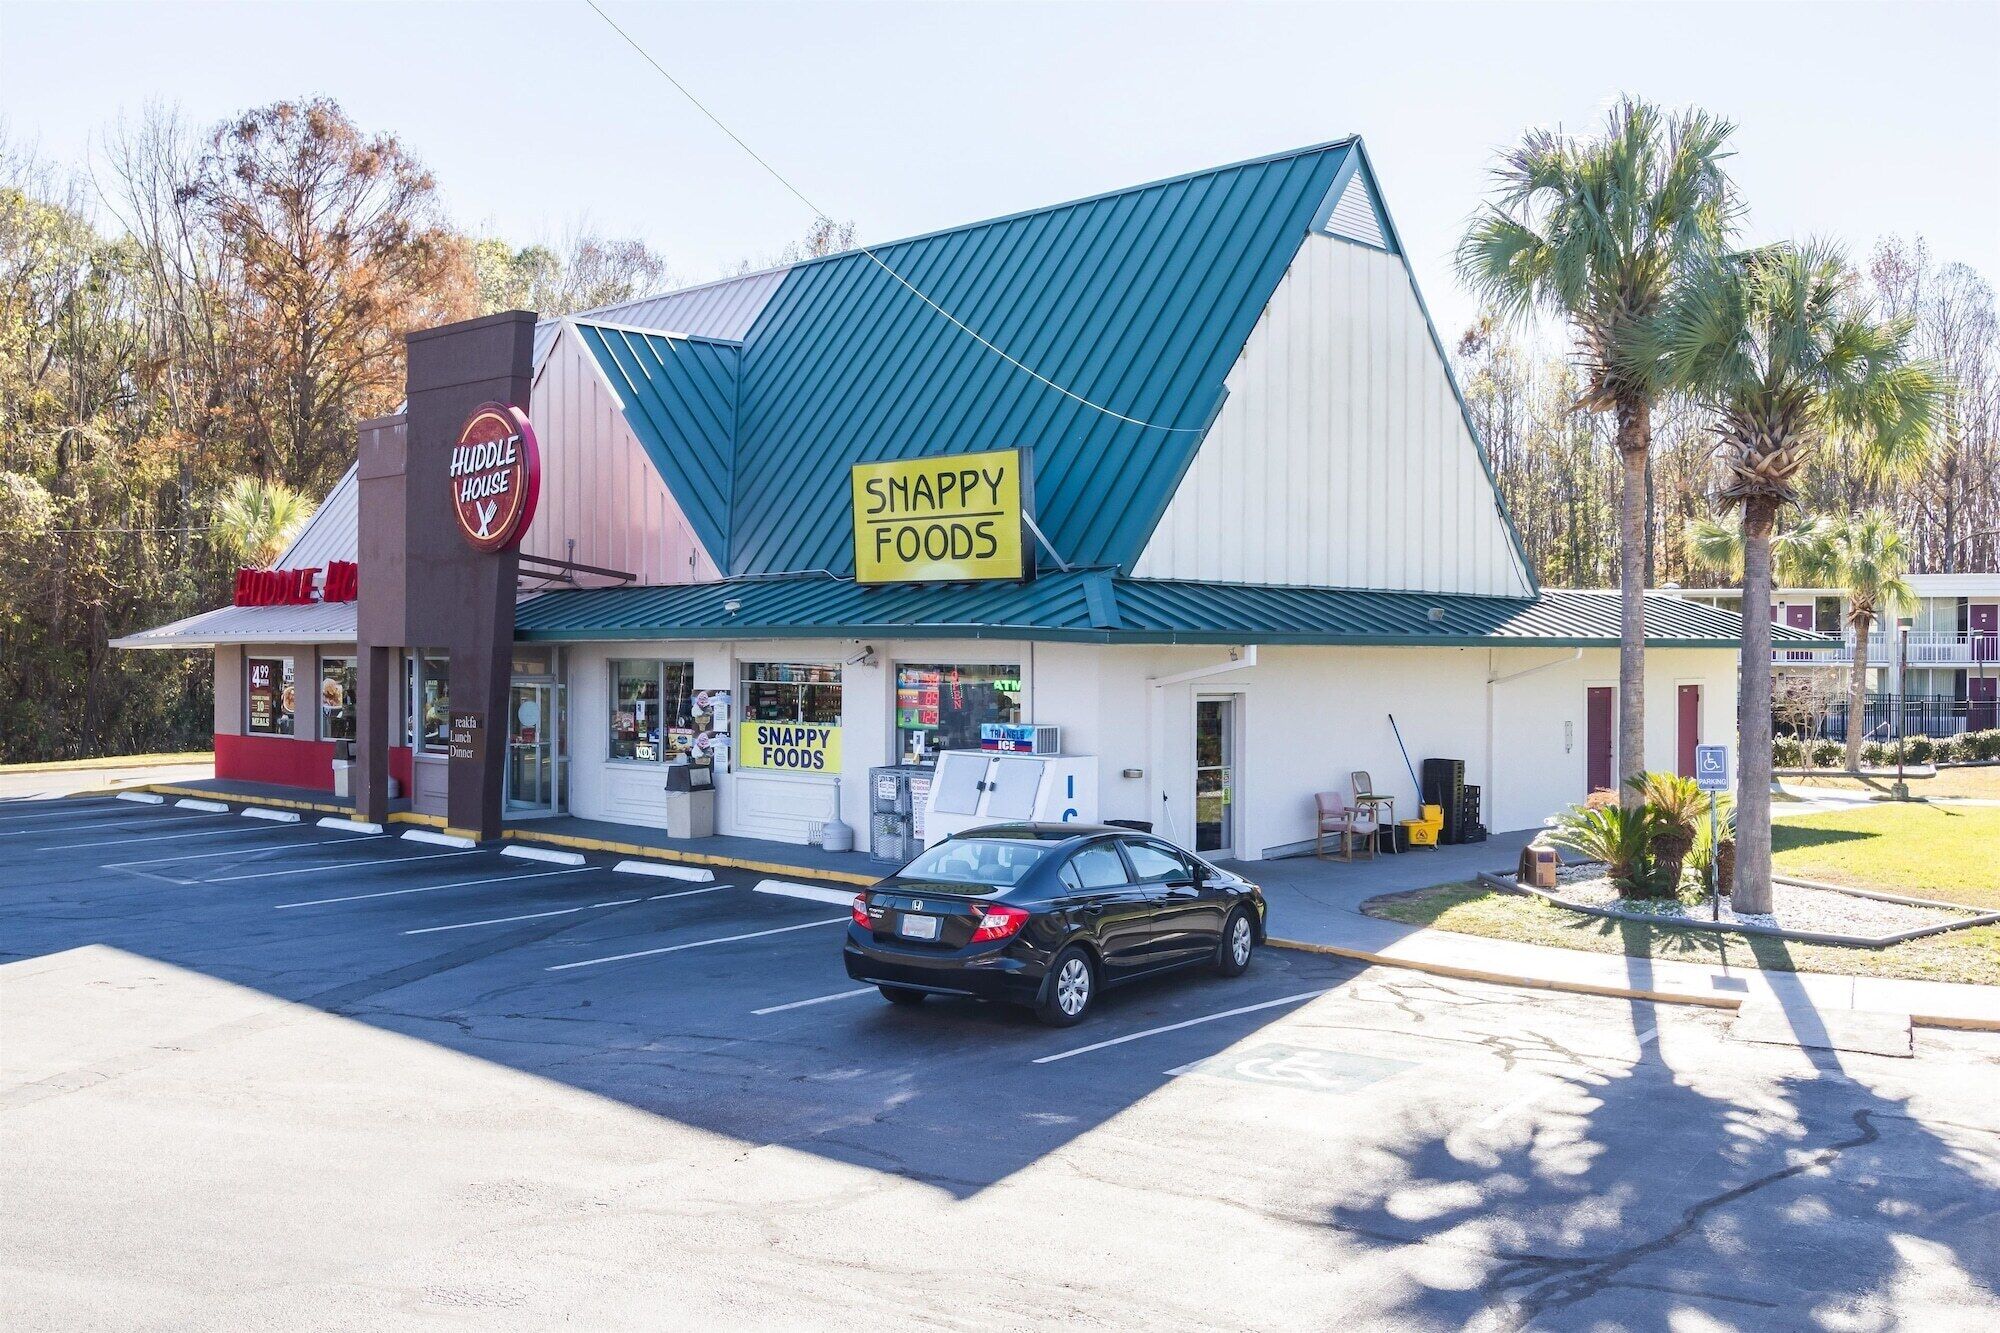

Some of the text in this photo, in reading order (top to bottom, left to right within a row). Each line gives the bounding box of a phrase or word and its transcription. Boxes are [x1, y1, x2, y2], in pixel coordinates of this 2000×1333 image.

[450, 435, 519, 477] HUDDLE
[461, 469, 511, 503] HOUSE
[866, 467, 1004, 515] SNAPPY
[876, 521, 997, 564] FOODS
[235, 567, 322, 607] HUDDLE
[951, 670, 962, 710] OPEN
[993, 680, 1021, 691] ATM
[450, 730, 472, 744] Lunch
[757, 726, 831, 749] SNAPPY
[997, 740, 1016, 751] ICE
[450, 744, 474, 759] Dinner
[636, 746, 655, 760] KOOL
[763, 747, 825, 770] FOODS
